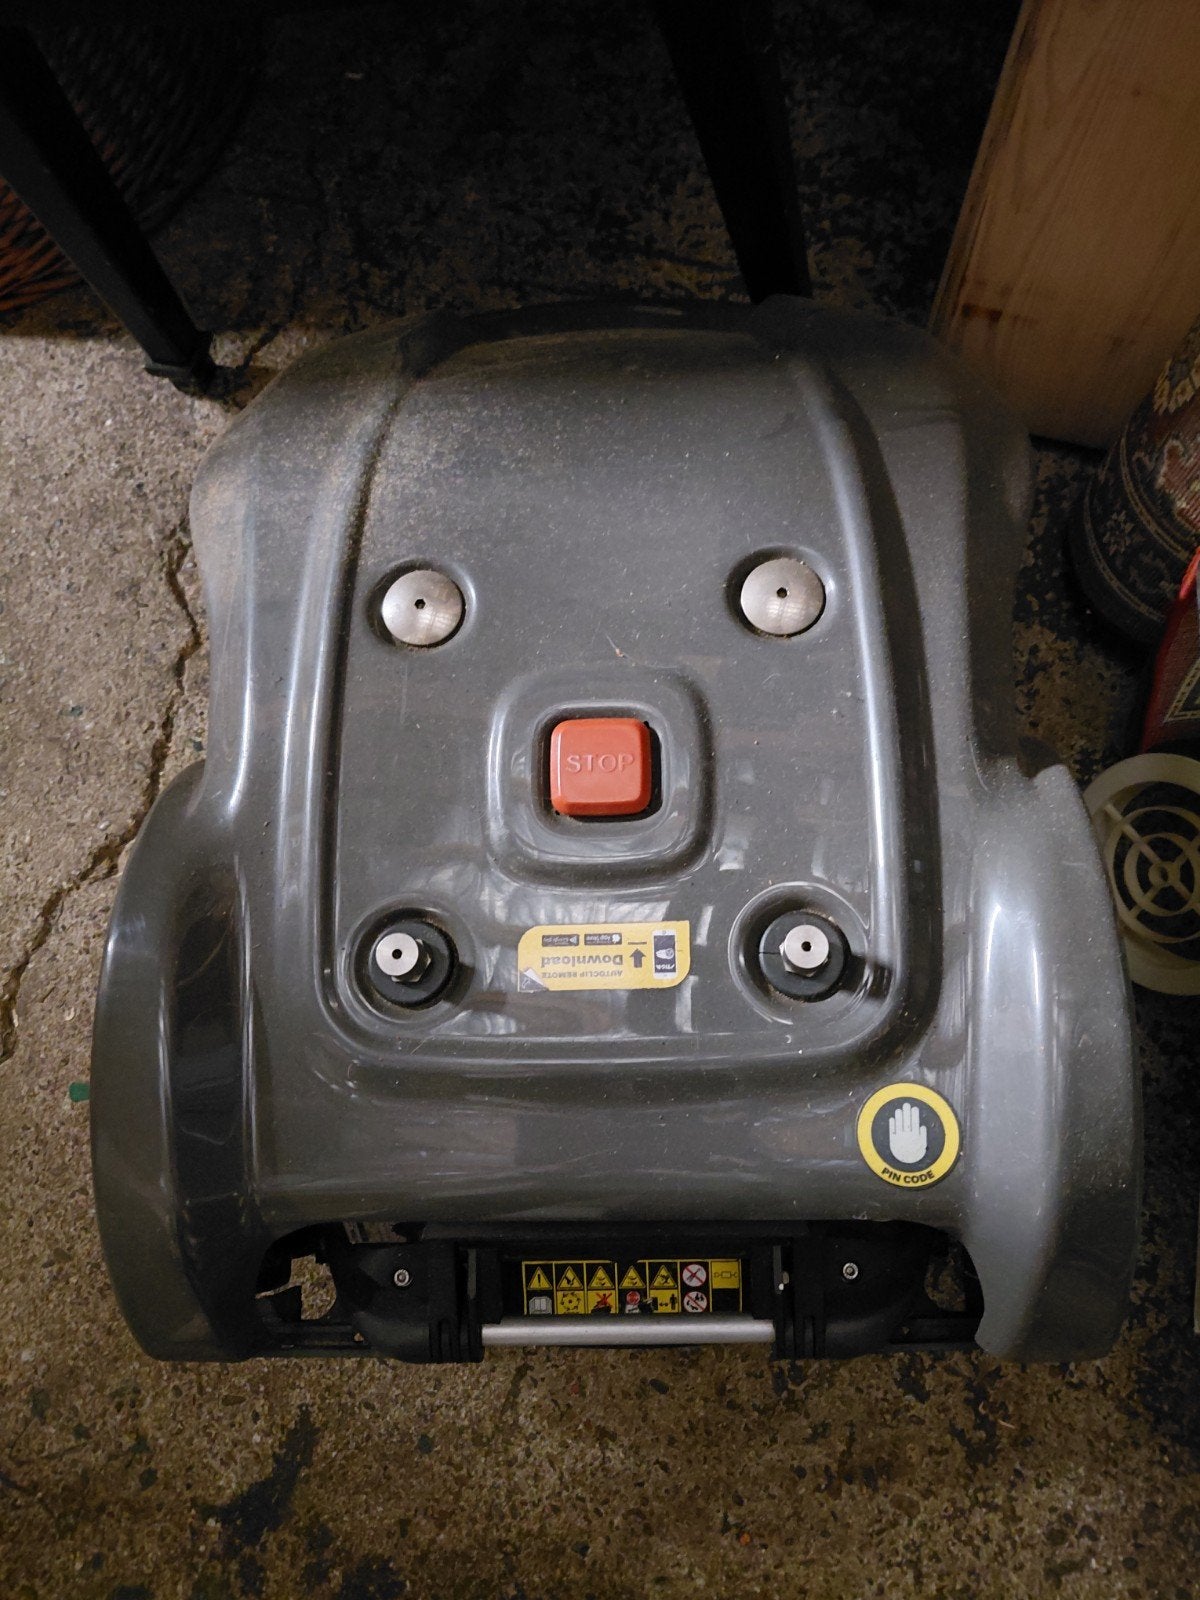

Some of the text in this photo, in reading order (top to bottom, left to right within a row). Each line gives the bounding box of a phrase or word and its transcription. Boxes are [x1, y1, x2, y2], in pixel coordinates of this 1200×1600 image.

[566, 753, 634, 773] STOP
[541, 955, 623, 968] Download
[580, 970, 623, 978] AUTOCLIP
[881, 1167, 935, 1184] PIN CODE
